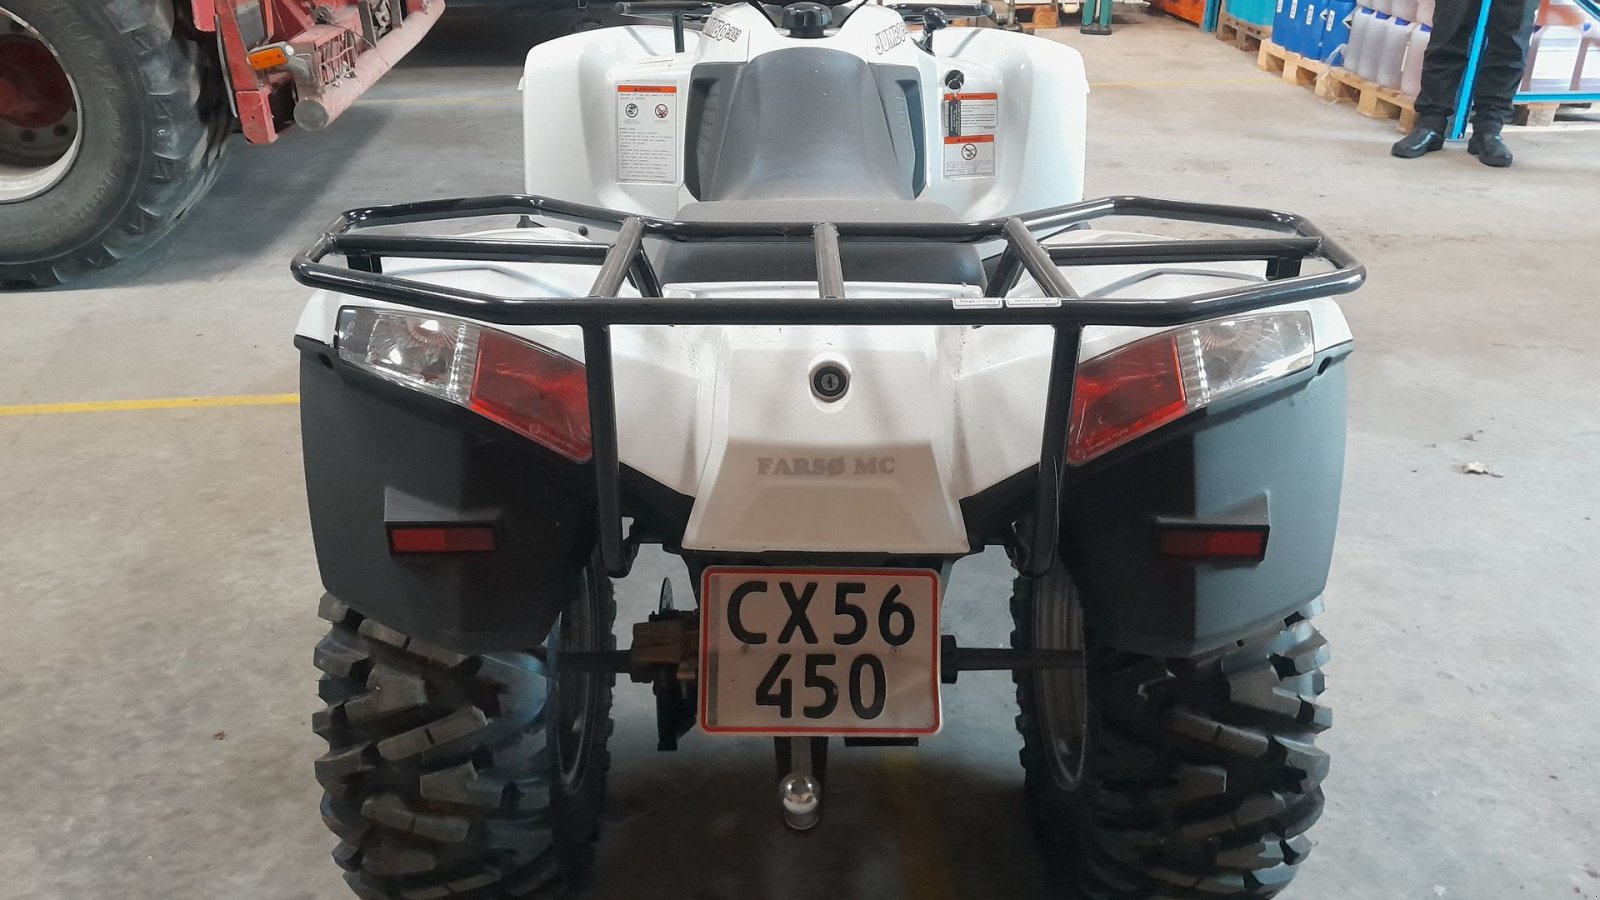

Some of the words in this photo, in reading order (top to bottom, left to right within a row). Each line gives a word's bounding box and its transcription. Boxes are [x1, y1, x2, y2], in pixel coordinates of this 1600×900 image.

[875, 22, 906, 55] JUMBO
[757, 456, 846, 477] FARSØ
[853, 456, 896, 475] MC
[756, 653, 886, 720] 450
